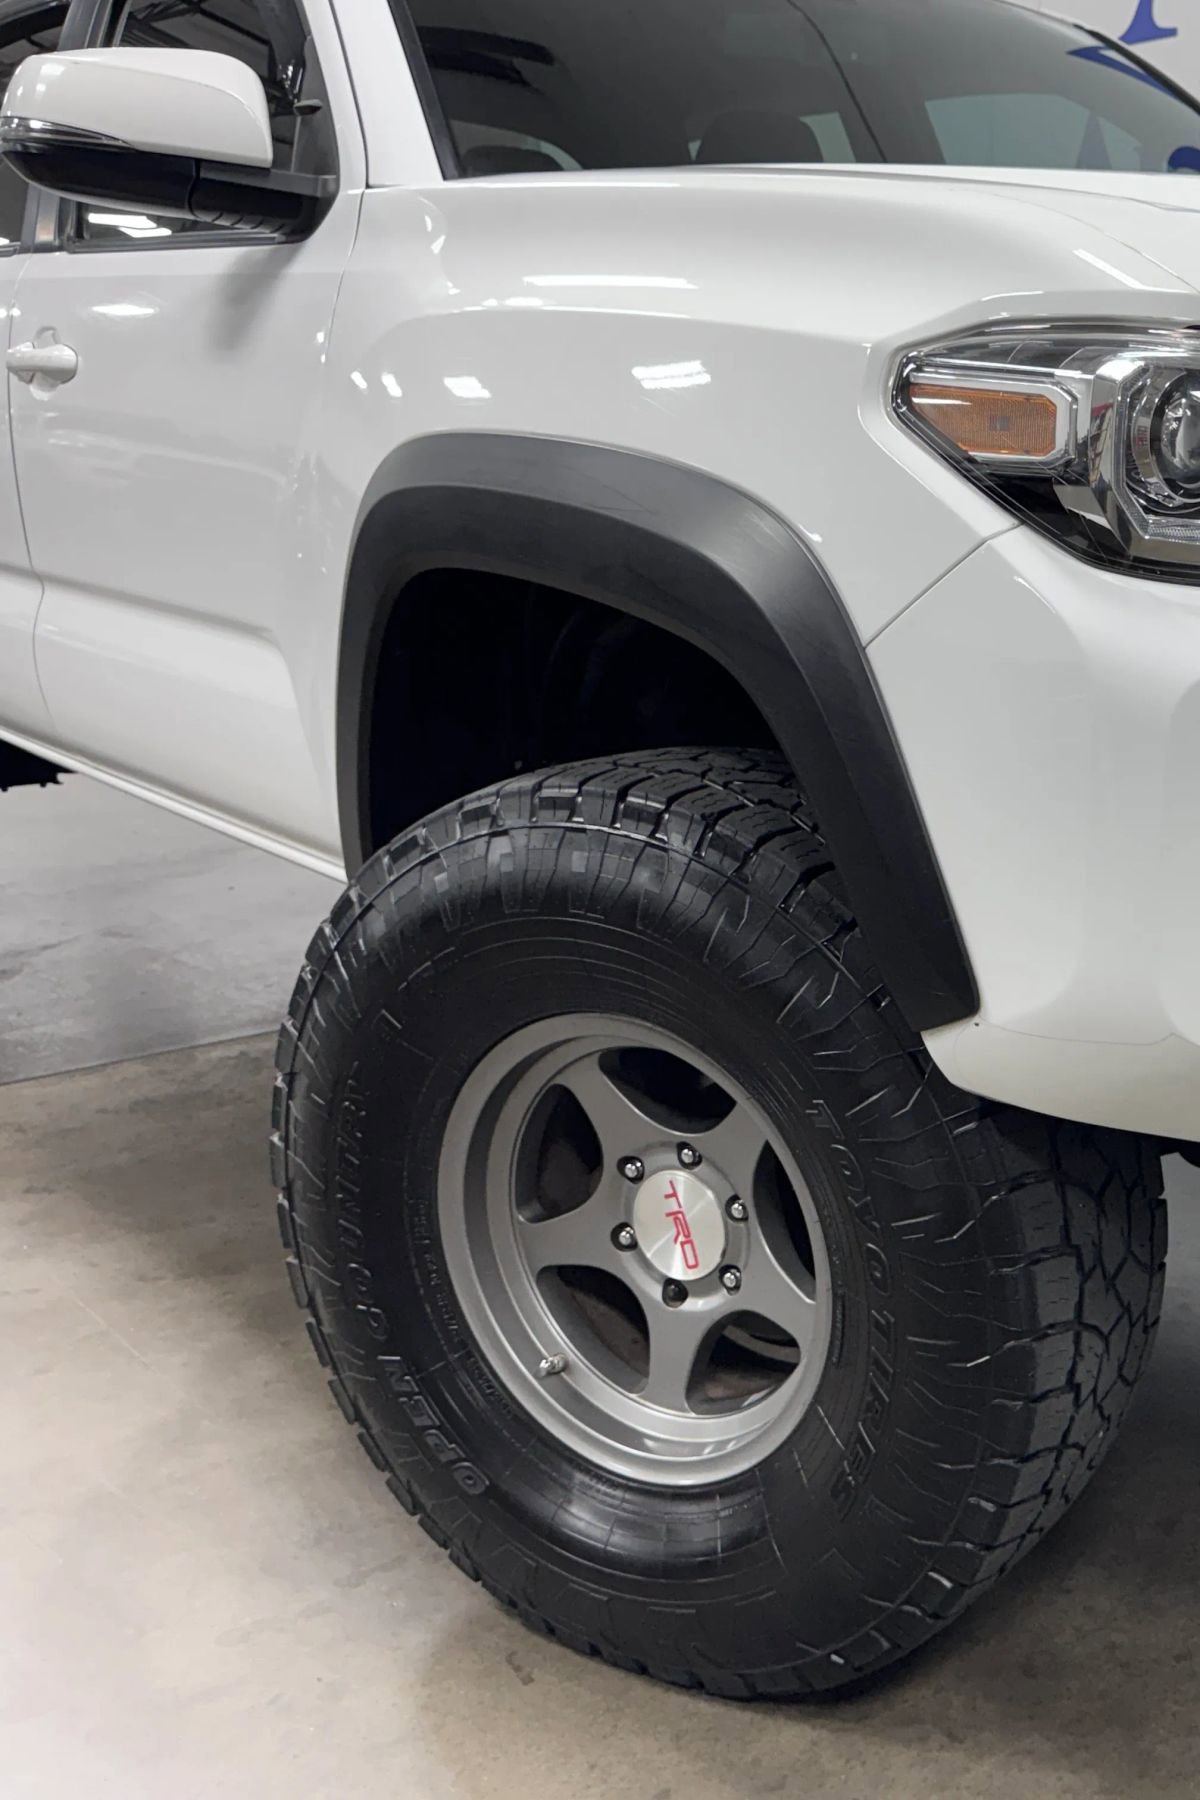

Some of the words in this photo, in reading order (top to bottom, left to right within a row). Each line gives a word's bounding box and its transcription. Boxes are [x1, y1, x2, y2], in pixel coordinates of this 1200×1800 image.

[663, 1180, 700, 1270] TRD
[804, 1099, 891, 1297] TOYO
[376, 1355, 491, 1496] OPEN
[828, 1309, 896, 1519] TIRES
